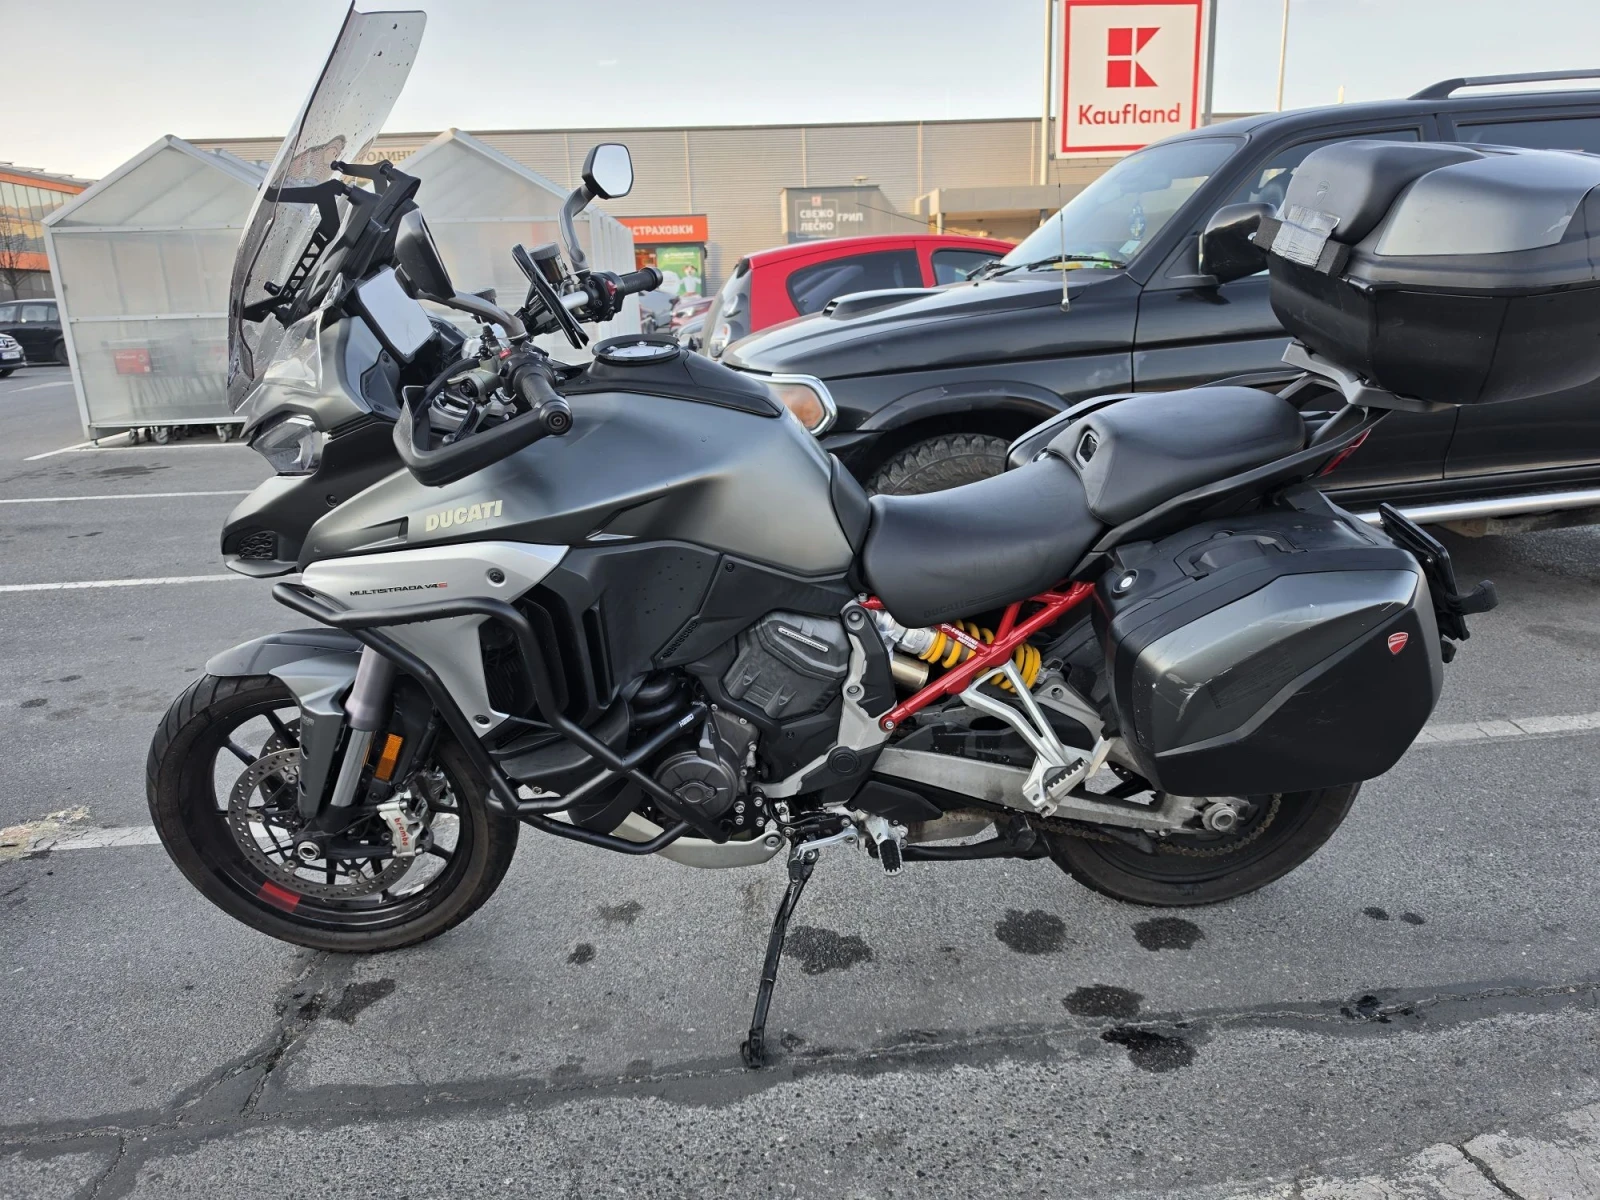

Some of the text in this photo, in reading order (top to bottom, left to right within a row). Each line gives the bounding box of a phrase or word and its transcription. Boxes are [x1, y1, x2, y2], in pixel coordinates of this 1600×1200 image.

[1078, 102, 1181, 125] Kaufland
[800, 209, 834, 218] СВЕЖО
[800, 222, 834, 231] ЛЕСНО
[425, 500, 503, 532] DUCATI
[350, 584, 423, 596] MULTISTRADA
[924, 600, 965, 618] DUCATI
[394, 817, 408, 847] brembo
